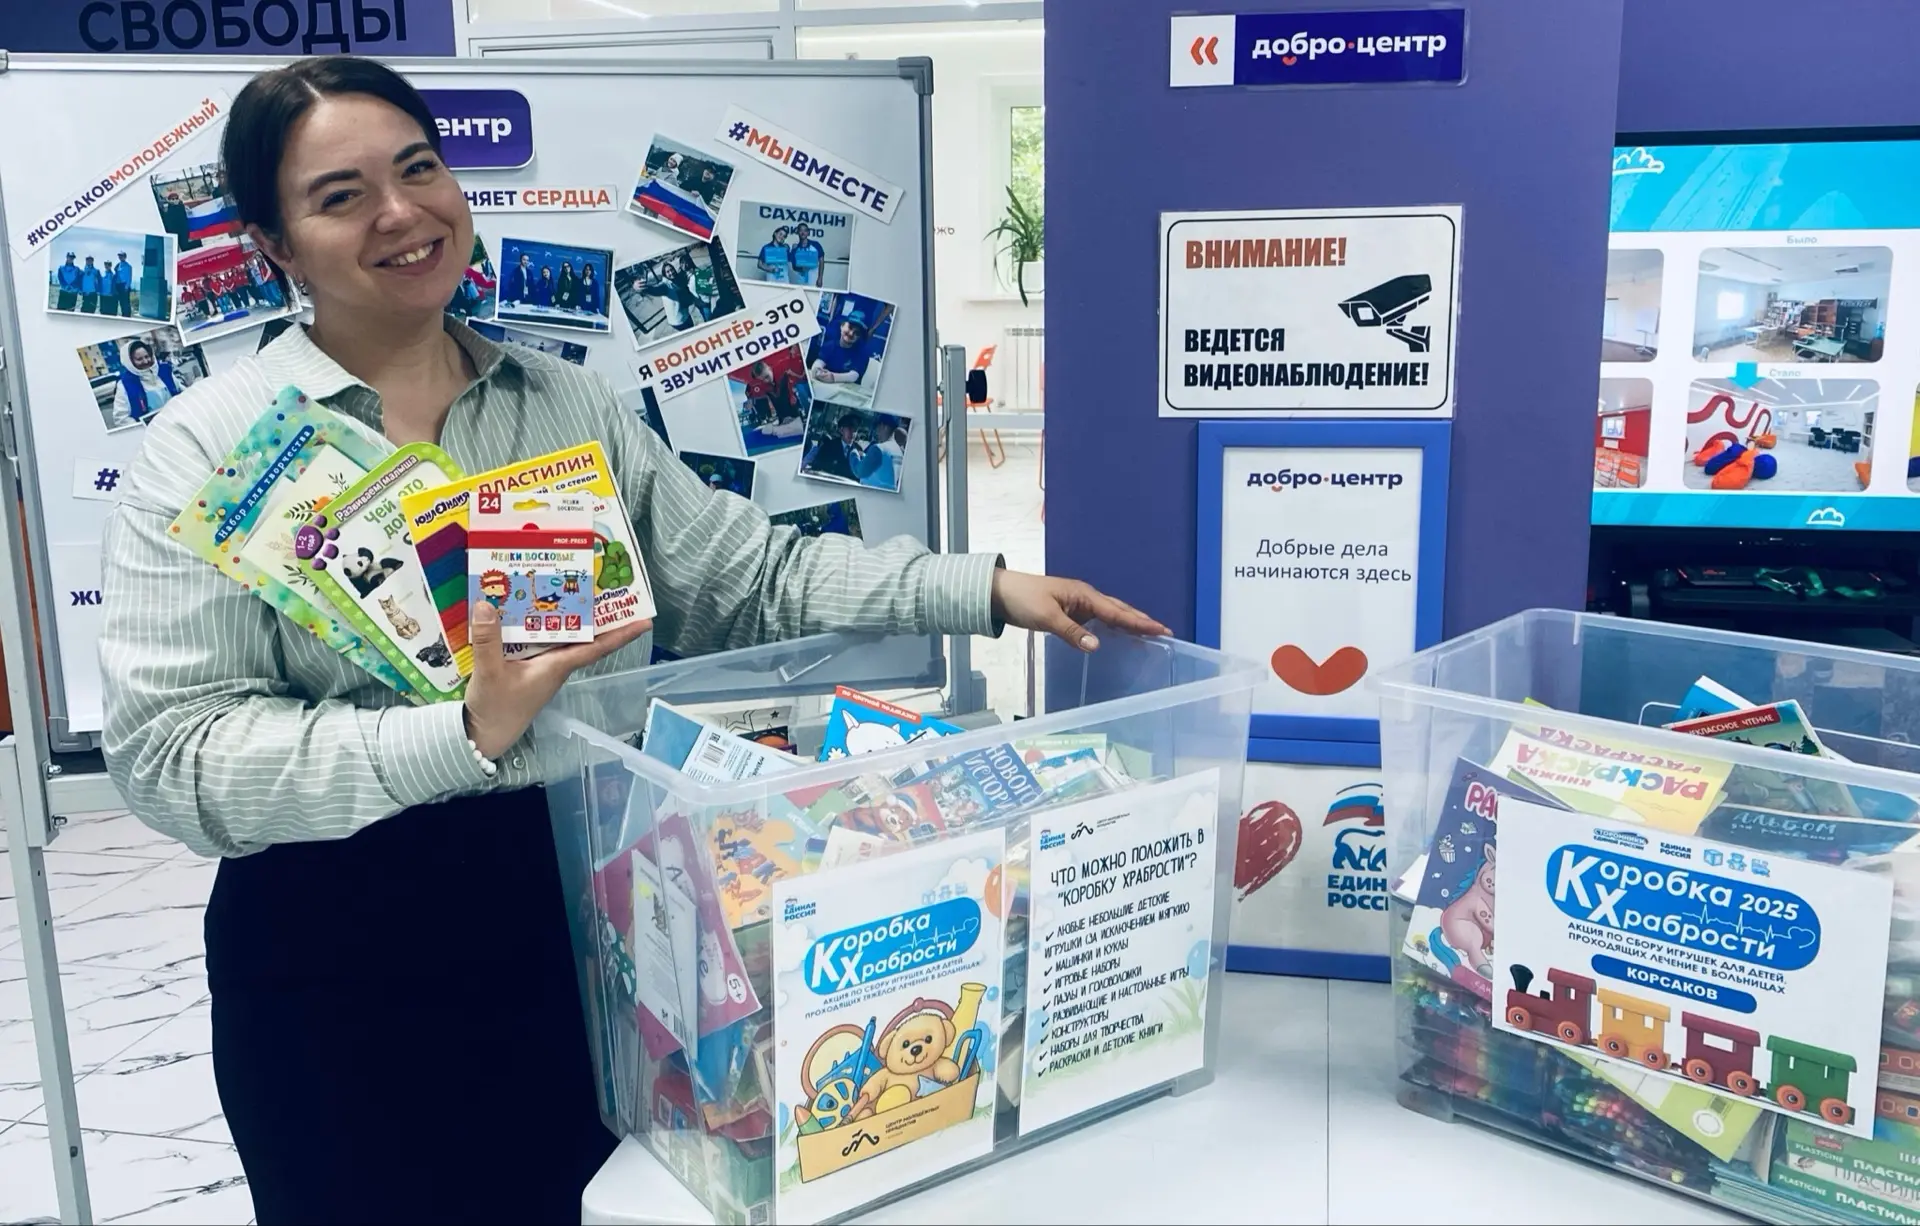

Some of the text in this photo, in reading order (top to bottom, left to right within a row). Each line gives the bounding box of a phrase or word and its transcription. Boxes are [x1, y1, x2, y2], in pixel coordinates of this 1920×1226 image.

[78, 0, 409, 54] СВОБОДЫ
[728, 121, 889, 213] #МЫВМЕСТЕ
[522, 188, 611, 208] СЕРДЦА
[759, 205, 846, 228] САХАЛИН
[1185, 237, 1347, 269] ВНИМАНИЕ!
[1785, 235, 1817, 245] Было
[638, 364, 654, 381] Я
[768, 298, 805, 325] ЭТО
[1184, 328, 1285, 356] ВЕДЕТСЯ
[660, 323, 800, 393] ЗВУЧИТ ГОРДО
[1184, 362, 1429, 390] ВИДЕОНАБЛЮДЕНИЕ!
[219, 428, 312, 540] Набор для творчества
[335, 455, 419, 522] Развиваем малыша
[478, 453, 595, 493] ПЛАСТИЛИН
[555, 481, 568, 491] со
[567, 473, 599, 489] стеком
[363, 498, 397, 525] Чей
[480, 497, 500, 510] 24
[524, 551, 575, 562] ВОСКОВЫЕ
[1256, 539, 1388, 558] Добрые дела
[1234, 564, 1412, 583] начинаются здесь
[596, 609, 635, 627] ШМЕЛЬ
[1742, 714, 1775, 728] ЧТЕНИЕ
[1517, 743, 1710, 800] РАСКРАСКА
[1040, 839, 1066, 851] РОССИЯ
[1051, 828, 1205, 887] ЧТО МОЖНО ПОЛОЖИТЬ В
[1660, 842, 1692, 853] ЕДИНАЯ
[1660, 848, 1692, 859] РОССИЯ
[1328, 892, 1389, 911] РОСС
[1554, 850, 1799, 921] Коробка 2025
[784, 902, 816, 915] ЕДИНАЯ
[784, 909, 816, 922] РОССИЯ
[1056, 891, 1170, 938] ЛЮБЫЕ НЕБОЛЬШИЕ ДЕТСКИЕ
[1587, 883, 1776, 960] Храбрости
[811, 913, 931, 989] Коробка
[1044, 938, 1083, 959] ИГРУШКИ
[1101, 914, 1156, 940] ИСКЛЮЧЕНИЕМ
[1568, 922, 1604, 938] АКЦИЯ
[1606, 931, 1623, 942] ПО
[1626, 934, 1664, 953] СБОРУ
[1666, 946, 1718, 968] ИГРУШЕК
[1720, 960, 1746, 974] ДЛЯ
[836, 940, 957, 991] Храбрости
[1055, 937, 1130, 972] МАШИНКИ И КУКЛЫ
[1568, 932, 1786, 995] ПРОХОДЯЩИХ ЛЕЧЕНИЕ В БОЛЬНИЦАХ
[823, 956, 964, 1006] АКЦИЯ ПО СБОРУ ИГРУШЕК ДЛЯ ДЕТЕЙ
[1053, 966, 1142, 1007] ПАЗЛЫ И ГОЛОВОЛОМКИ
[1054, 957, 1121, 988] ИГРОВЫЕ НАБОРЫ
[1626, 967, 1719, 1000] КОРСАКОВ
[728, 978, 743, 1001] 5+
[804, 997, 862, 1019] ПРОХОДЯЩИХ
[898, 976, 930, 991] ЛЕЧЕНИЕ
[937, 960, 981, 979] БОЛЬНИЦАХ
[1052, 966, 1190, 1024] РАЗВИВАЮЩИЕ И НАСТОЛЬНЫЕ ИГРЫ
[1050, 1014, 1145, 1056] НАБОРЫ ДЛЯ ТВОРЧЕСТВА
[1051, 1010, 1109, 1040] КОНСТРУКТОРЫ
[1049, 1023, 1163, 1073] РАСКРАСКИ И ДЕТСКИЕ КНИГИ
[1795, 1143, 1844, 1164] PLASTICINE
[1779, 1174, 1827, 1197] PLASTICINE
